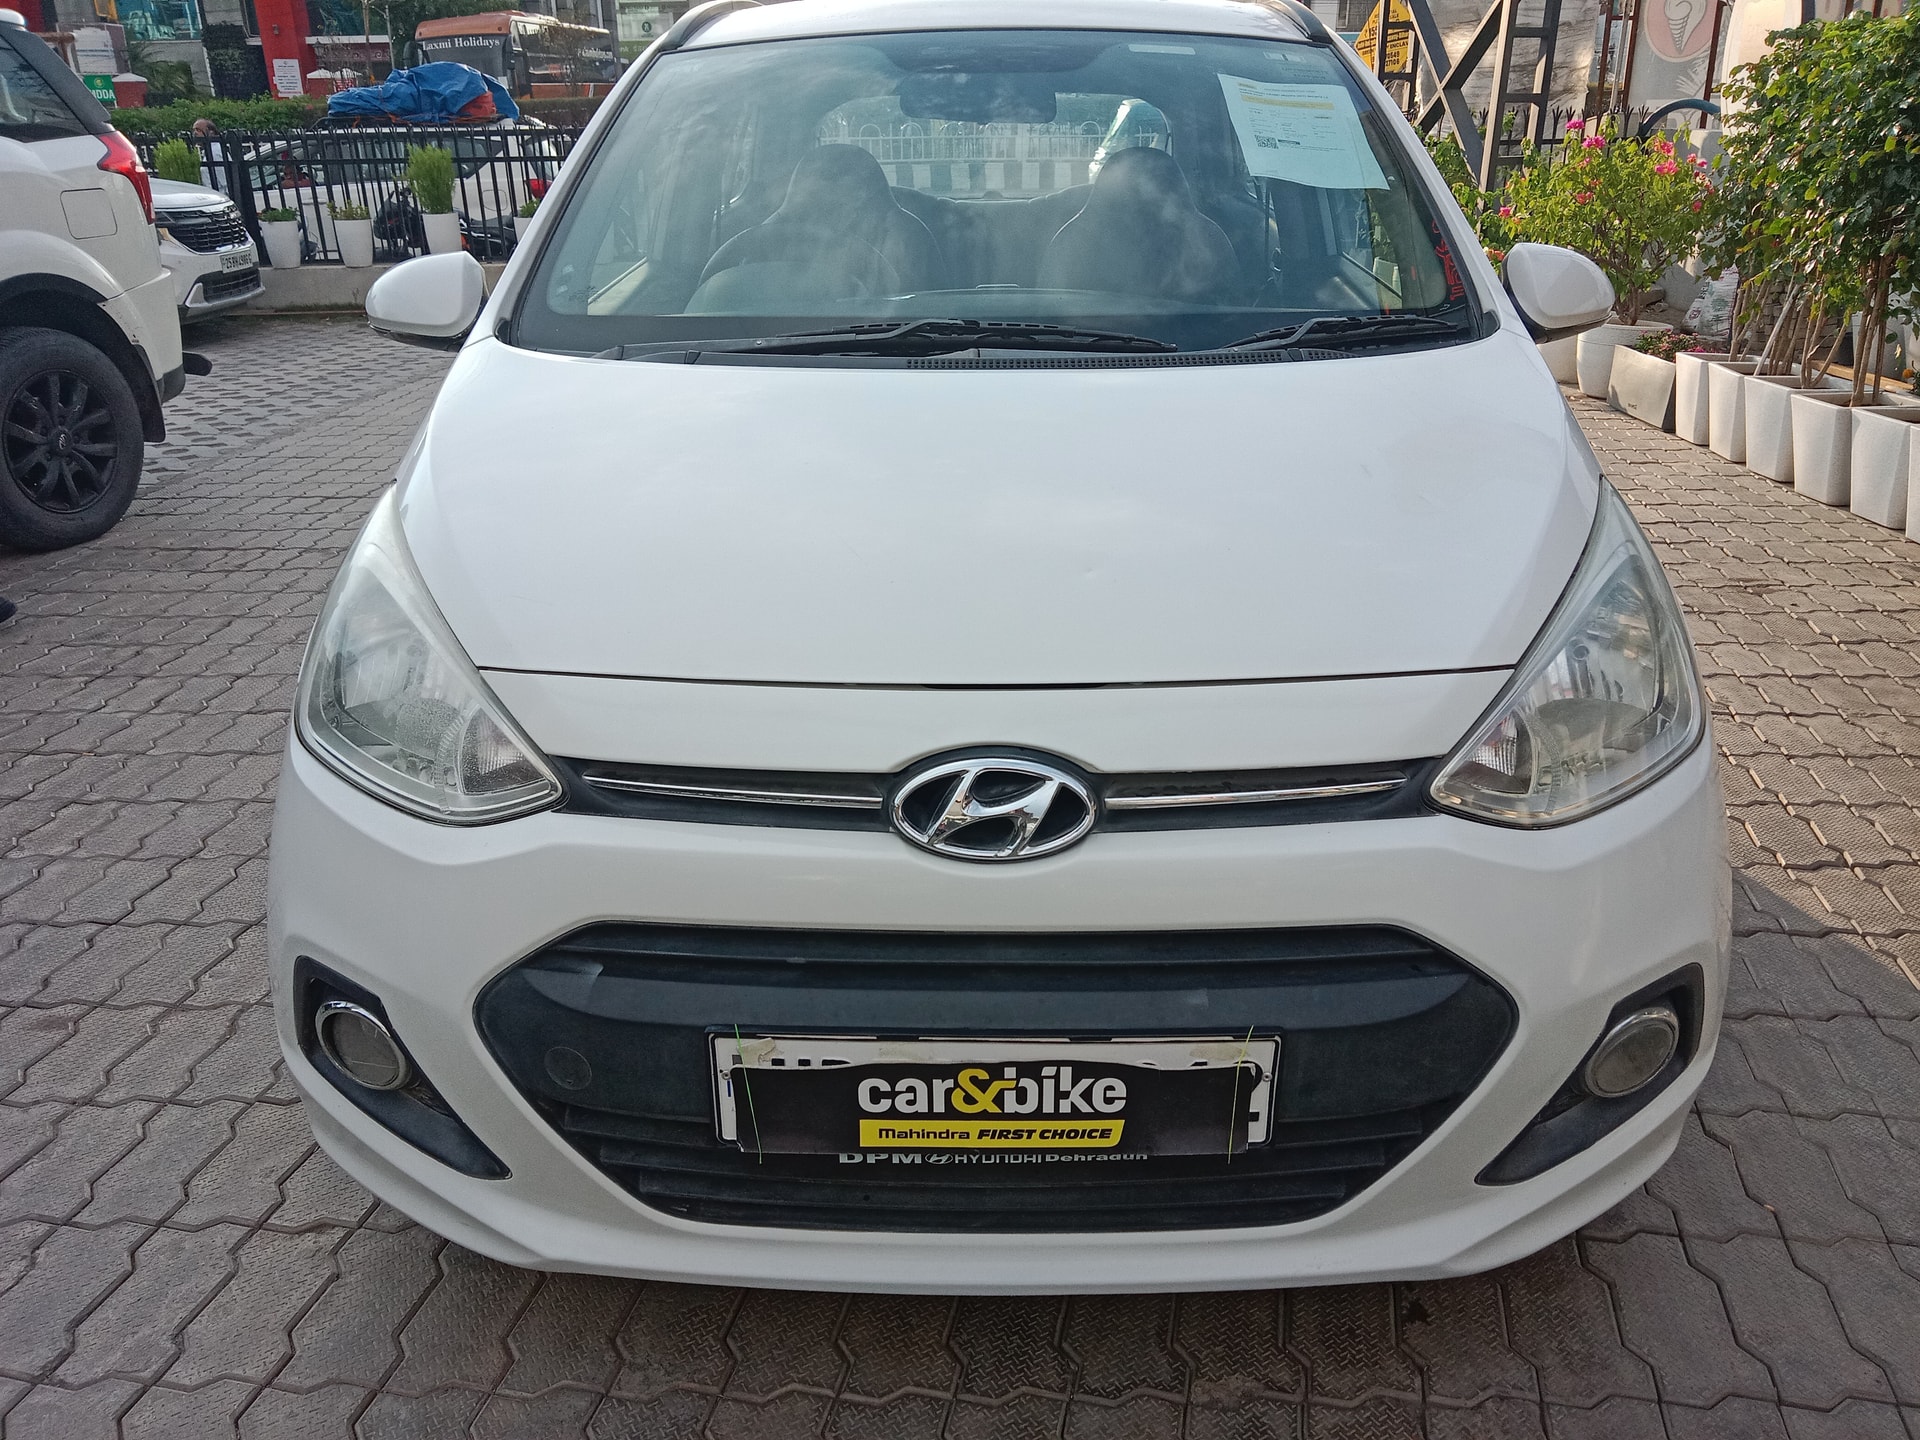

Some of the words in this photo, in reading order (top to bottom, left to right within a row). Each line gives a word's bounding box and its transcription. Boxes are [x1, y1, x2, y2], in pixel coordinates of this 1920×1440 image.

[422, 39, 452, 51] Laxmi
[454, 36, 500, 48] Holidays
[857, 1066, 1127, 1114] car&bike
[878, 1128, 970, 1140] Mahindra
[977, 1128, 1038, 1140] FIRST
[1038, 1128, 1113, 1140] CHOICE
[838, 1152, 923, 1164] DPM
